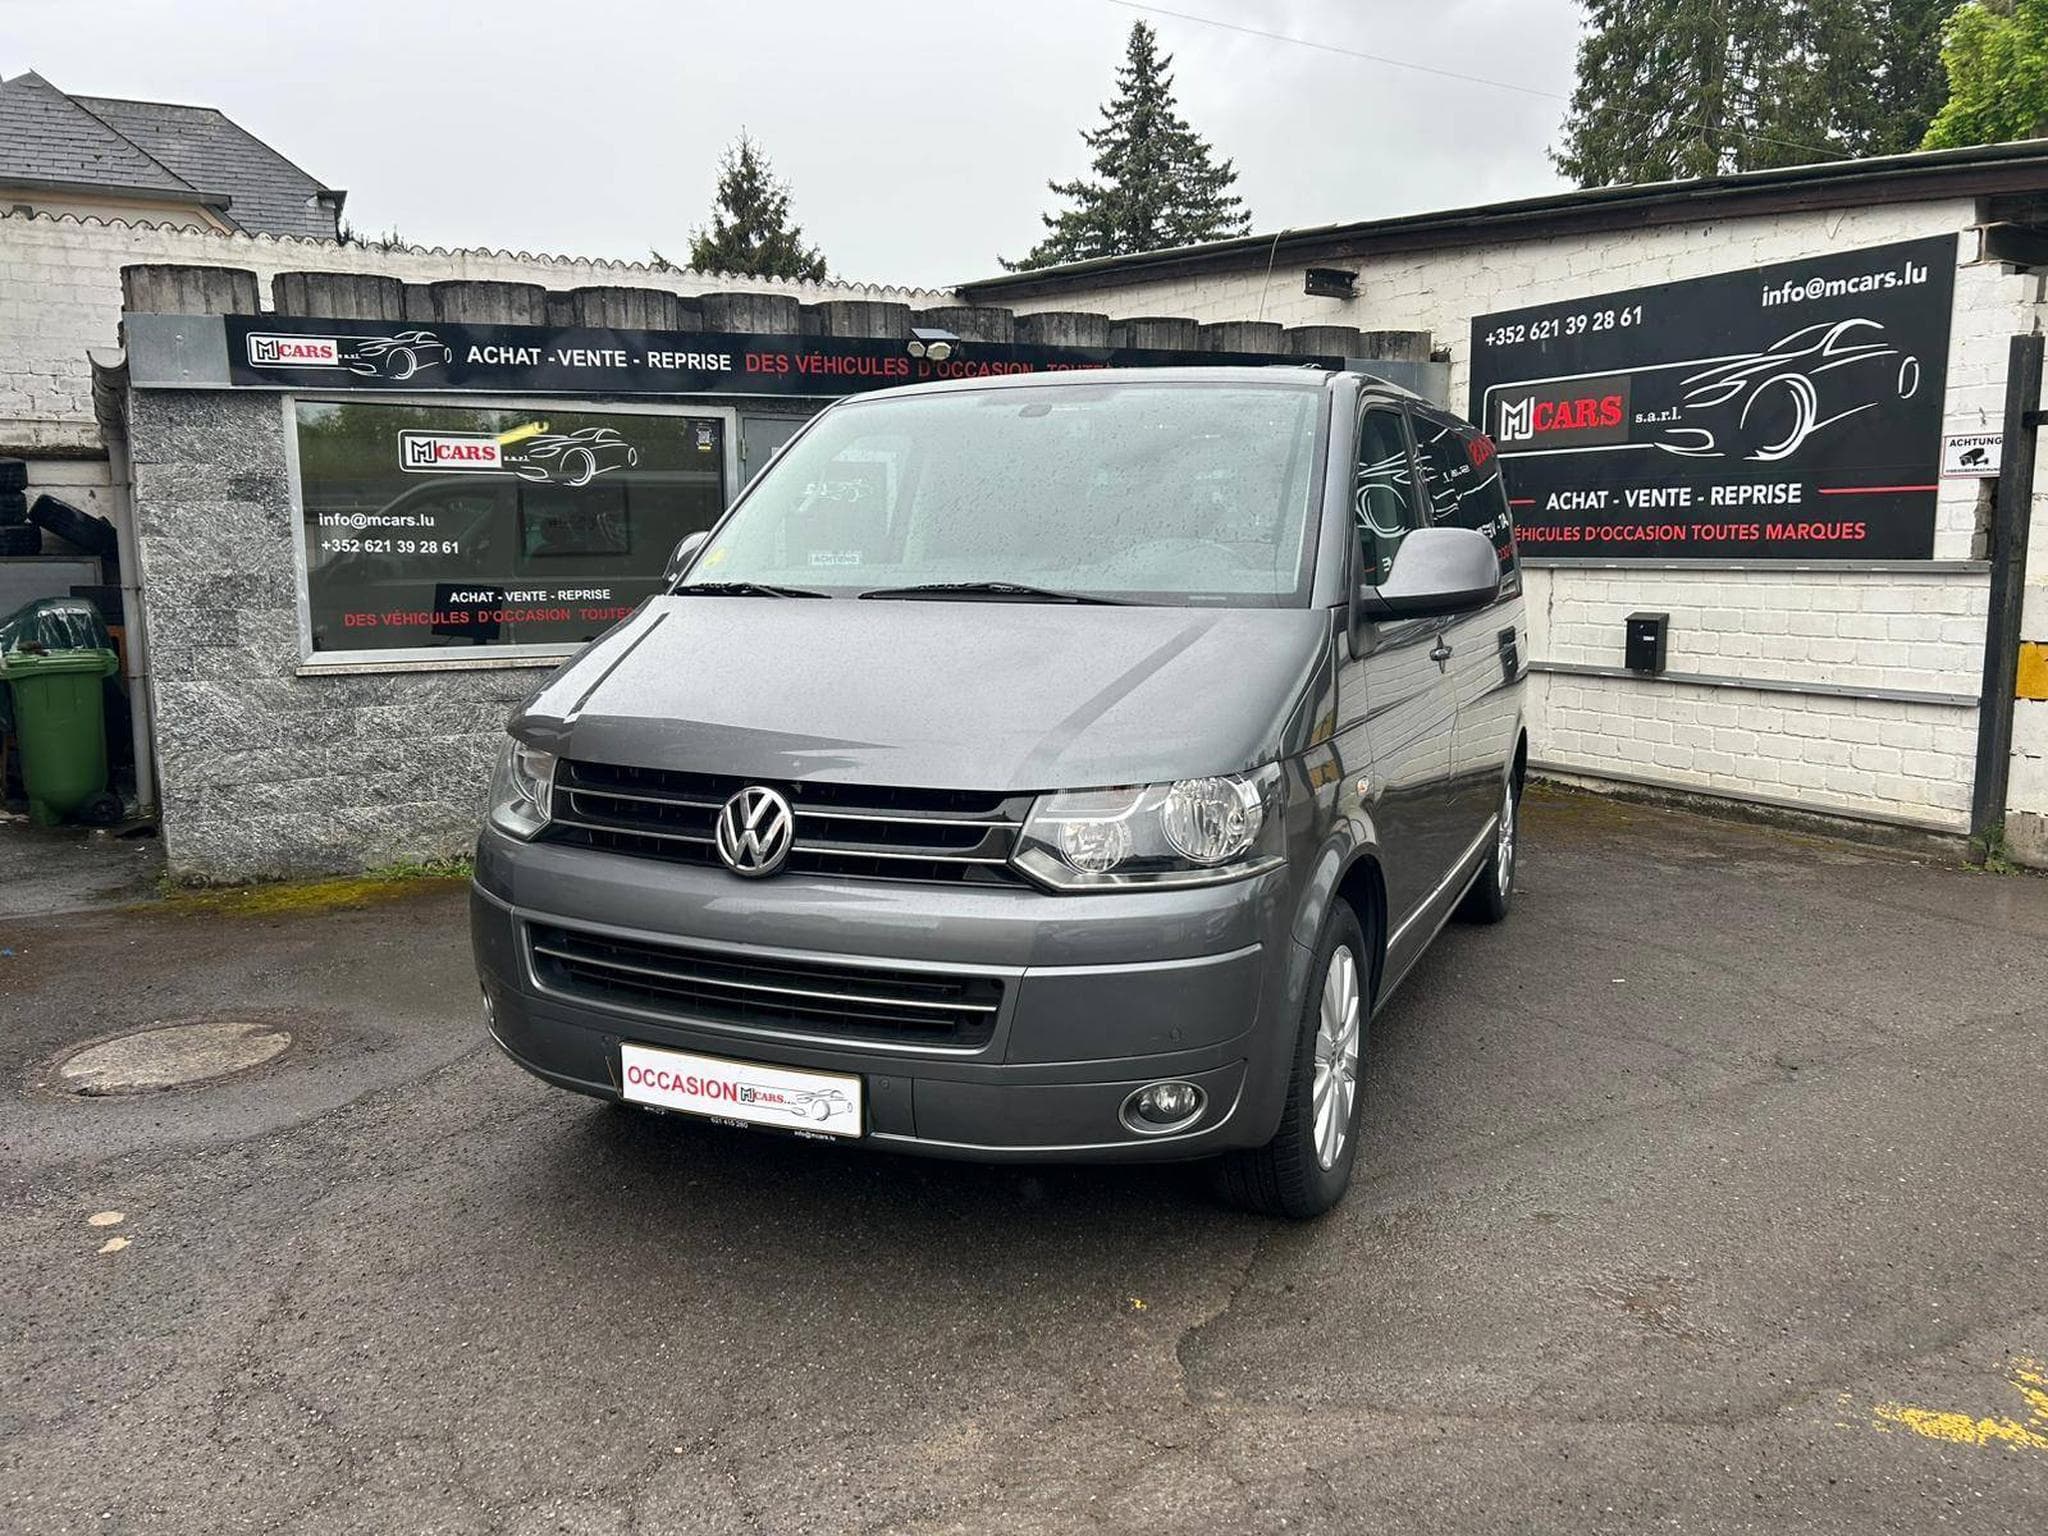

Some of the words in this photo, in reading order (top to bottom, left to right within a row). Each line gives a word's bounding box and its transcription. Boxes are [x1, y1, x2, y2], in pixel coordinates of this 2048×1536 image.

[1762, 264, 1928, 308] info@mcars.lu
[1485, 325, 1525, 346] +352
[1530, 319, 1560, 341] 621
[1565, 315, 1588, 336] 39
[1592, 310, 1615, 332] 28
[1620, 305, 1643, 327] 61
[467, 346, 541, 365] ACHAT
[647, 351, 732, 371] REPRISE
[745, 354, 789, 374] DES
[796, 351, 909, 377] VÉHICULES
[1546, 493, 1609, 510] ACHAT
[1624, 489, 1693, 508] VENTE
[1710, 484, 1802, 506] REPRISE
[319, 512, 435, 529] info@mcars.lu
[1514, 523, 1580, 542] ÉHICULES
[1585, 525, 1687, 541] D'OCCASION
[1691, 524, 1760, 541] TOUTES
[1765, 522, 1866, 541] MARQUES
[321, 539, 360, 553] +352
[364, 539, 391, 553] 621
[396, 540, 415, 554] 39
[420, 540, 438, 554] 28
[442, 541, 459, 554] 61
[450, 591, 494, 603] ACHAT
[504, 590, 548, 602] VENTE
[557, 588, 611, 601] REPRISE
[343, 613, 377, 627] DES
[381, 608, 470, 626] VÉHICULES
[477, 608, 571, 624] D'OCCASION
[627, 1066, 737, 1102] OCCASION
